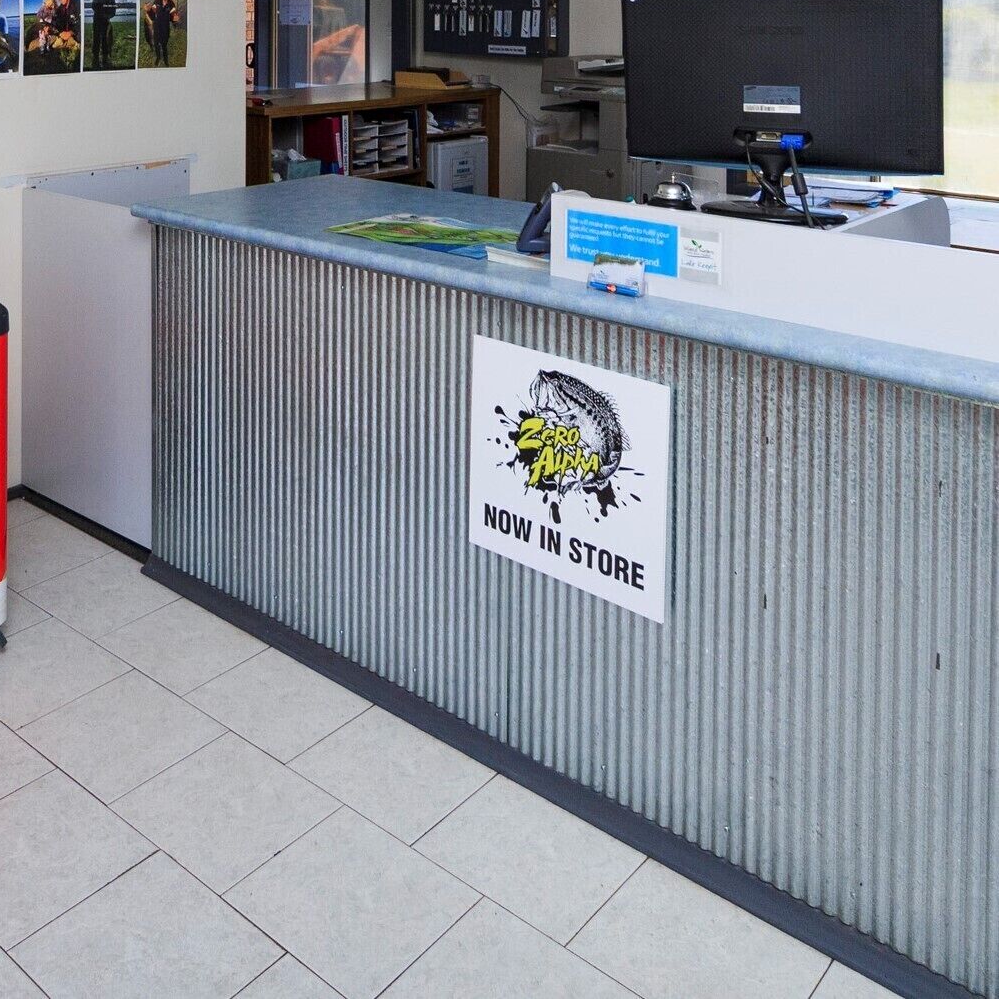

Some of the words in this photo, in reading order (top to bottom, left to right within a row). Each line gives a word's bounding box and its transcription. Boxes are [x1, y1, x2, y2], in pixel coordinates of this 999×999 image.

[569, 243, 582, 253] We
[484, 503, 533, 543] NOW
[540, 524, 561, 557] IN
[569, 536, 645, 592] STORE
